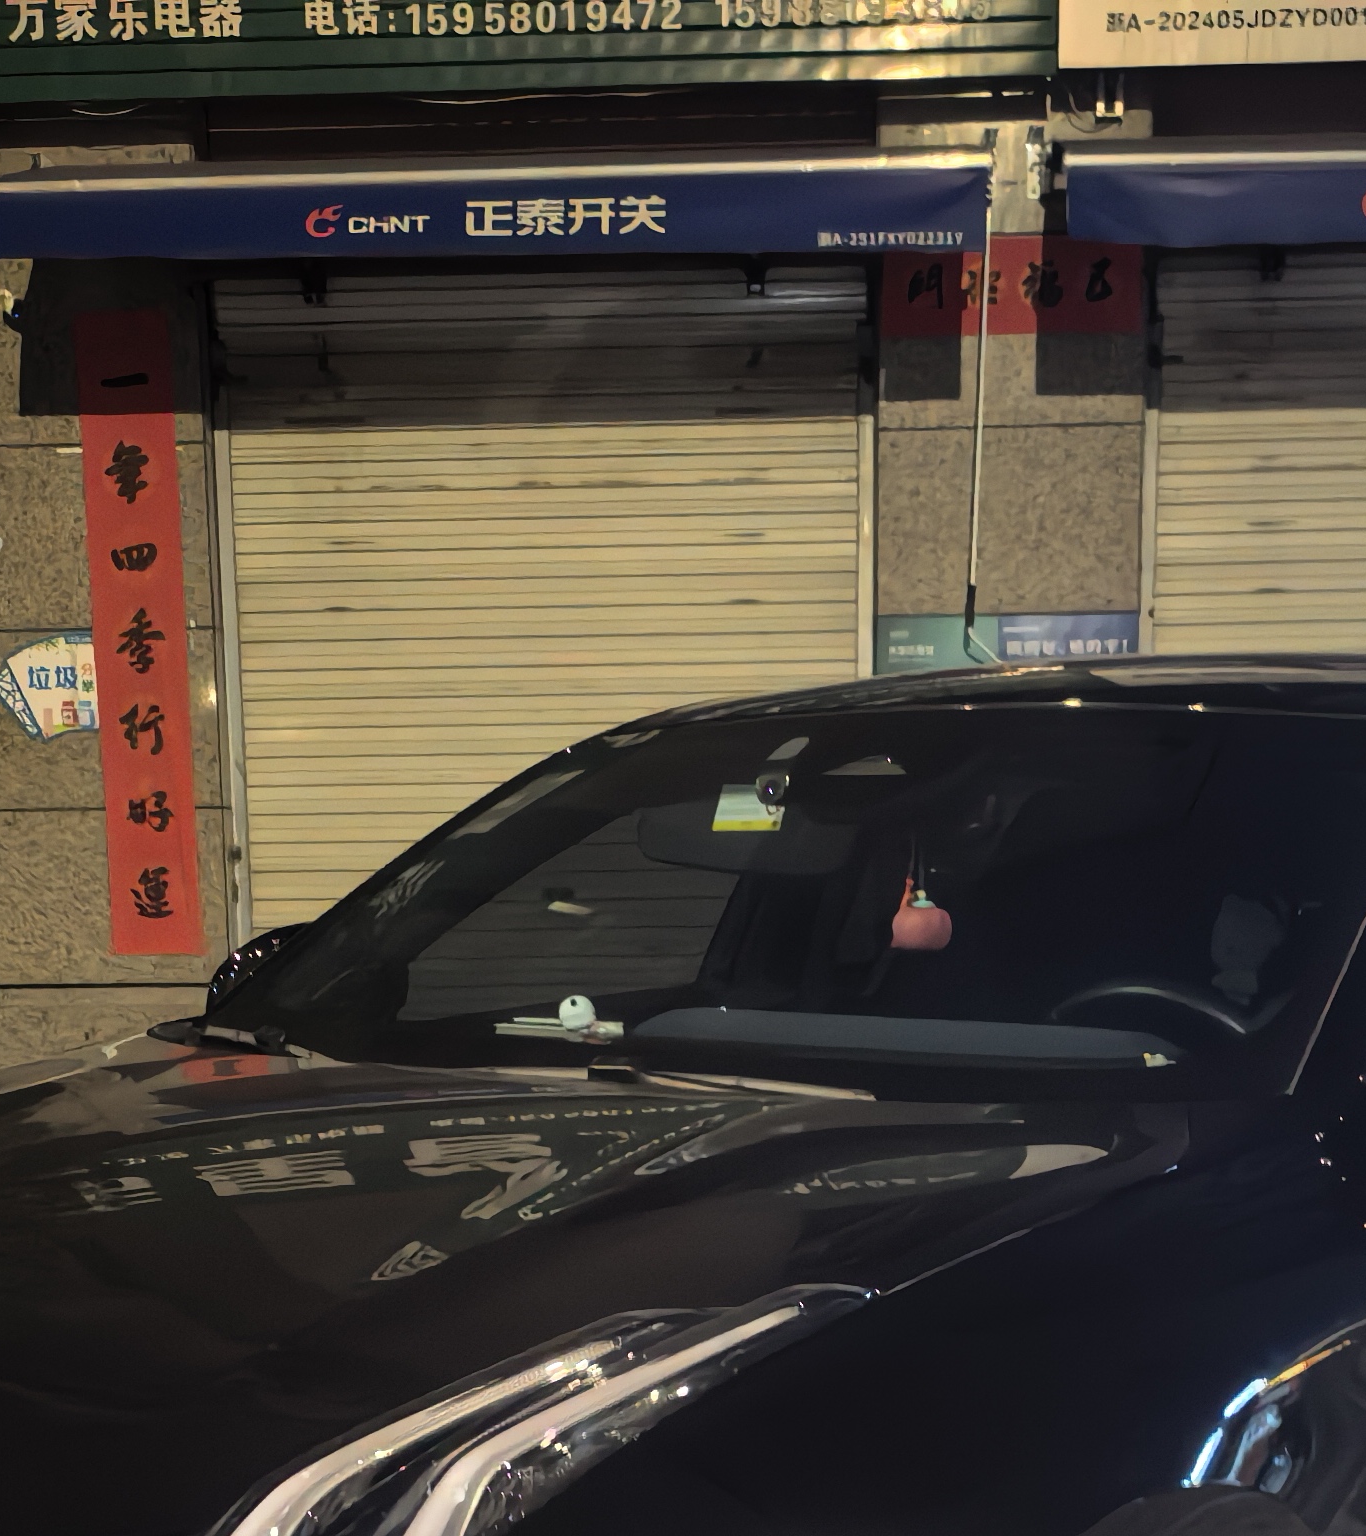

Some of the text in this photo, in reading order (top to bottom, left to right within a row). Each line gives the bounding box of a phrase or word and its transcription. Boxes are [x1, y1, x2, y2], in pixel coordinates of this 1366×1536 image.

[8, 0, 243, 44] 万家乐电器
[464, 194, 667, 237] 正泰开关
[27, 665, 78, 690] 垃圾
